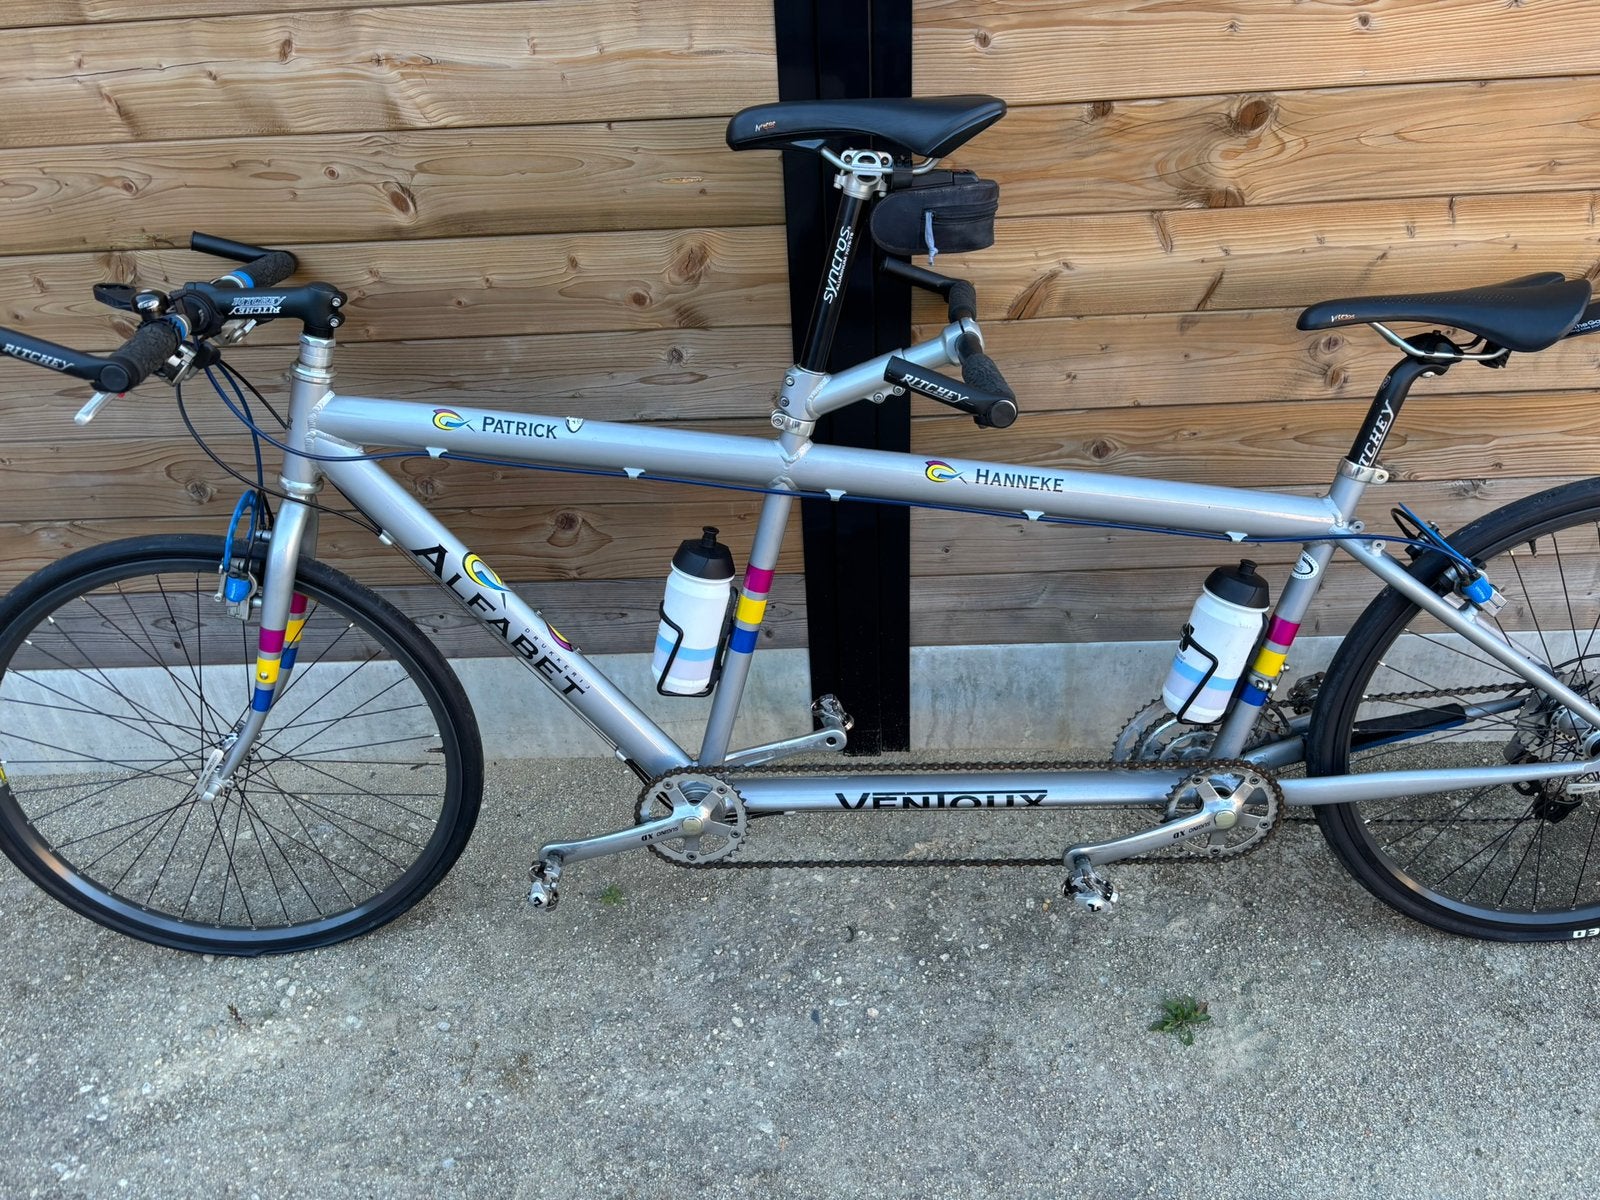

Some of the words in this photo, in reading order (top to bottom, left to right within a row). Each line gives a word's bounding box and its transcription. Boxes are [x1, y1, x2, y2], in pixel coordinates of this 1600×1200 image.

[228, 305, 282, 316] RITCHEY
[3, 342, 75, 371] RITCHEY
[901, 372, 970, 404] RITCHEY
[481, 415, 558, 441] PATRICK
[1358, 398, 1395, 468] TCHEY
[975, 467, 1065, 493] HANNEKE
[414, 542, 587, 698] ALFABET
[523, 626, 592, 691] DRUKKERIJ
[641, 833, 653, 842] XD
[1173, 830, 1186, 839] XD
